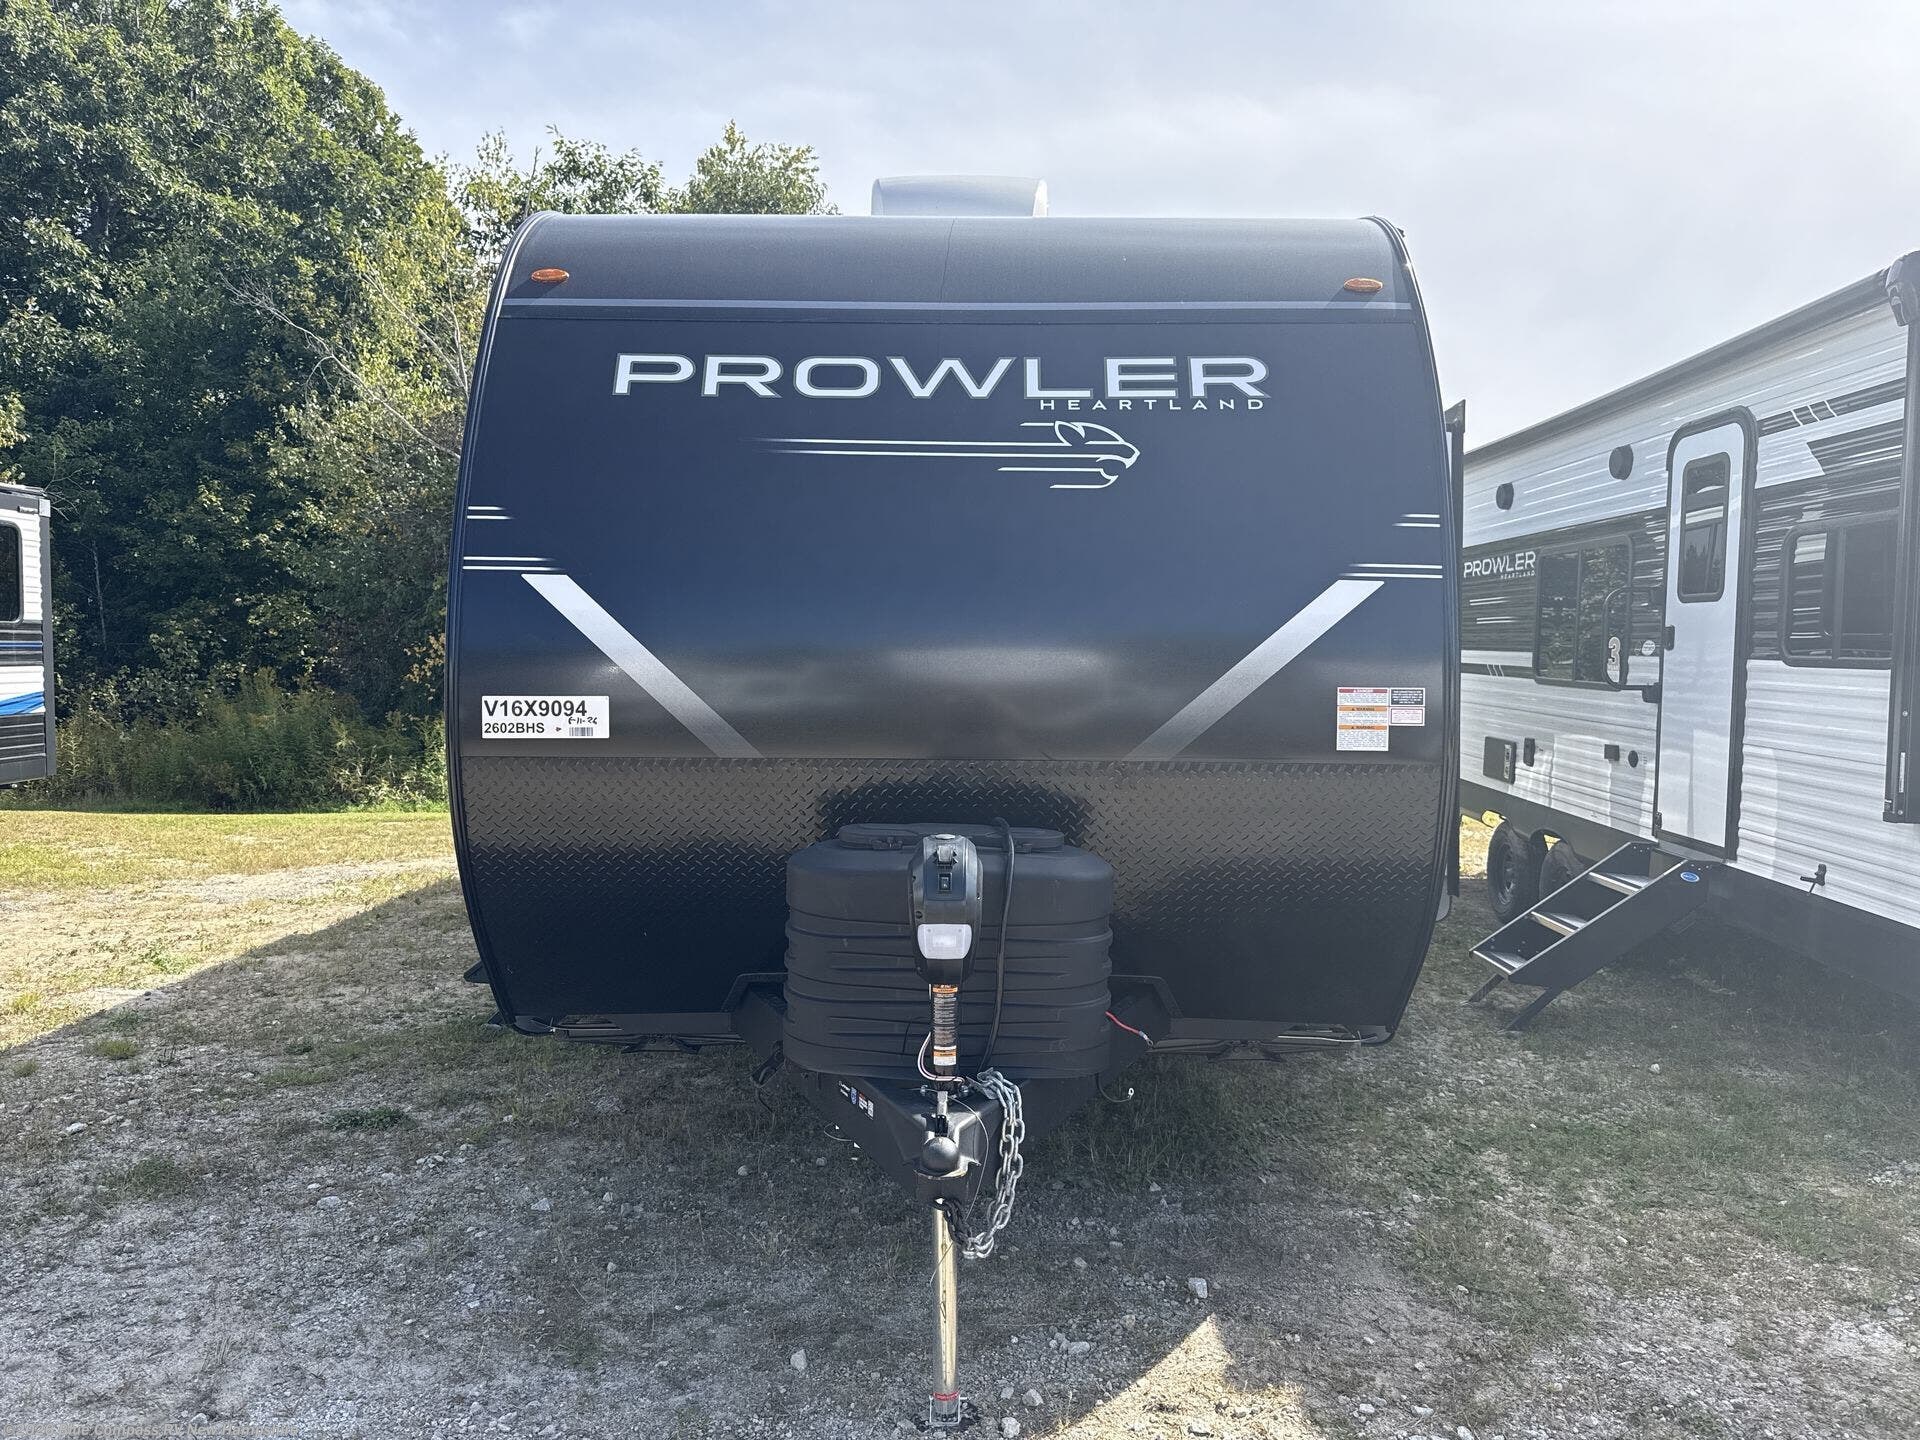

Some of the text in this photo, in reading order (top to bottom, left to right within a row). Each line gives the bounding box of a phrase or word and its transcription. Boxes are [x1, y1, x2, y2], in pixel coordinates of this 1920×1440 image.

[612, 353, 1270, 399] PROWLER
[1039, 399, 1265, 411] HEARTLAND
[1463, 551, 1536, 578] PROWLER
[484, 700, 587, 717] V16X9094
[484, 722, 545, 734] 2602BHS
